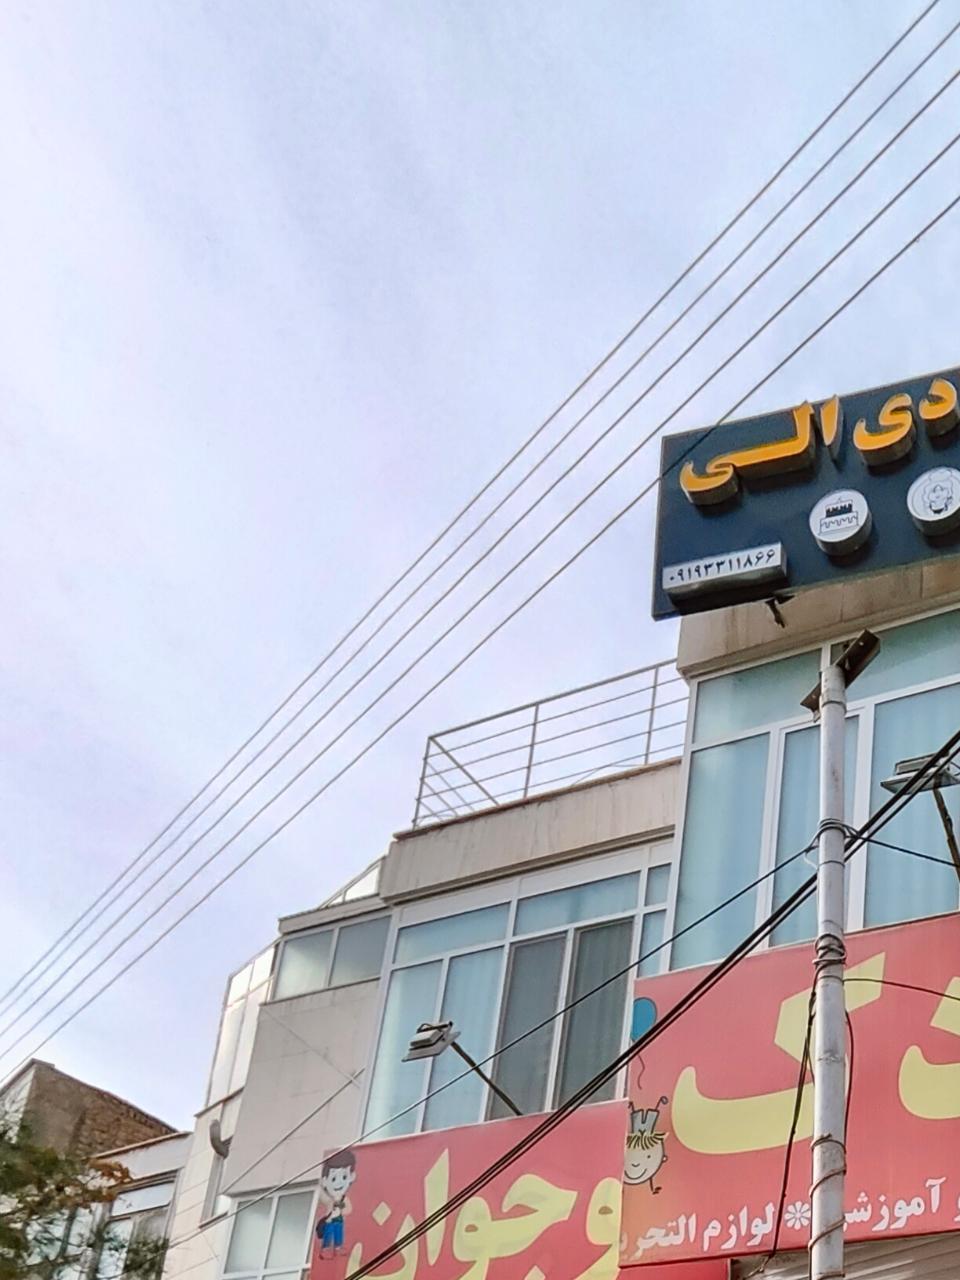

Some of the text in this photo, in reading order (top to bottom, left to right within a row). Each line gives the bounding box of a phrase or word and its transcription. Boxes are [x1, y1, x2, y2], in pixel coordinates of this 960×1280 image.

[680, 395, 843, 494] الی
[669, 549, 776, 582] ۰۹۱۹۳۳۱۱۸۶۶
[703, 1202, 775, 1252] لوازم
[843, 1177, 946, 1232] آموزش
